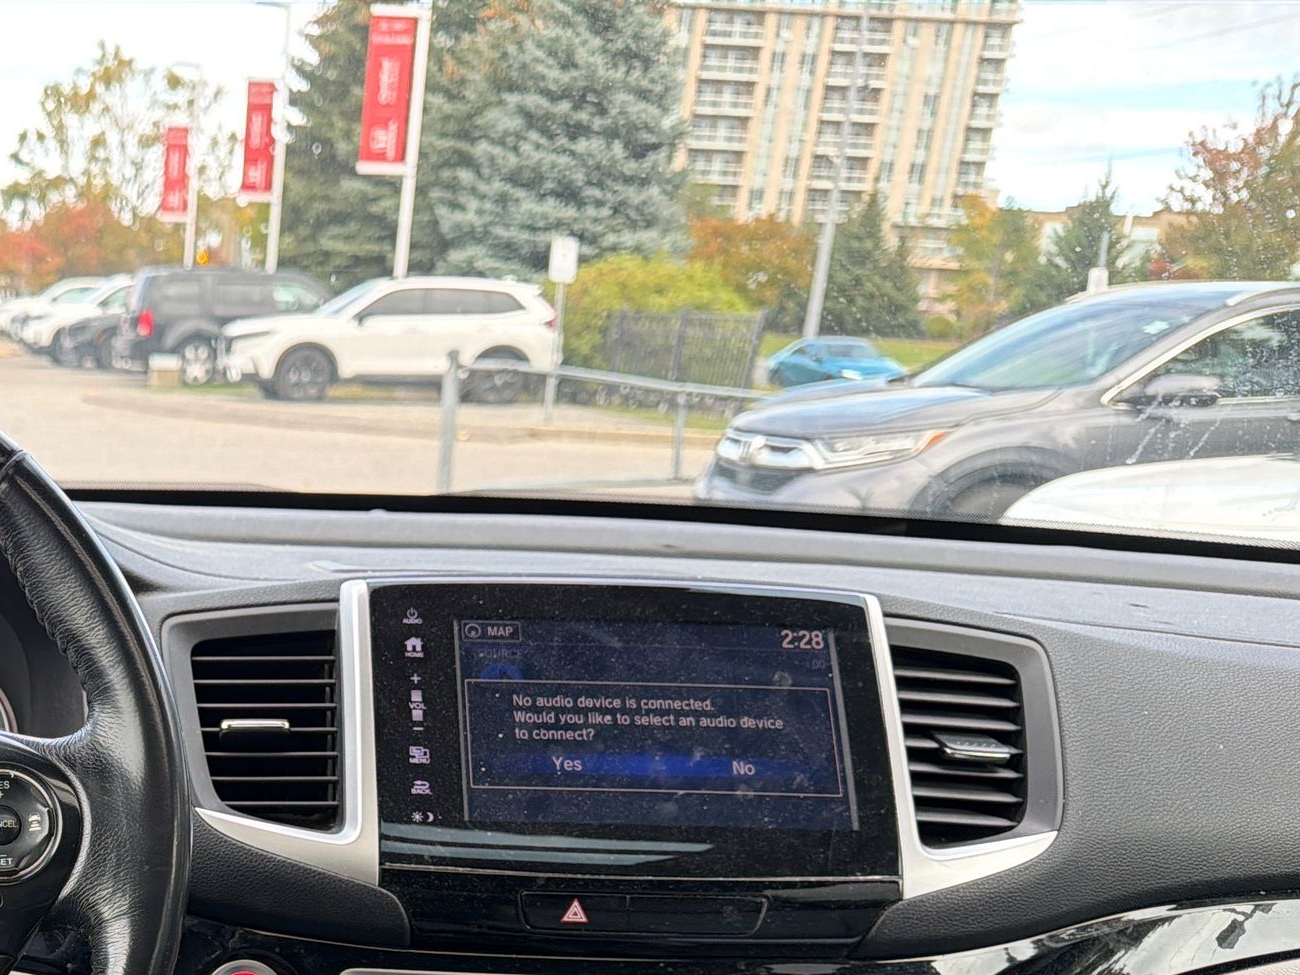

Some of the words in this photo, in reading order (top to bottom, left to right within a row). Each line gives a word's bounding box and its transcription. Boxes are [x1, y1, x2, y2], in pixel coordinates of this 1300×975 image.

[487, 626, 513, 637] MAP
[781, 629, 824, 649] 2:28
[409, 702, 426, 710] VOL
[512, 694, 532, 707] No
[536, 695, 573, 708] audio
[577, 695, 621, 708] device
[625, 696, 636, 709] is
[640, 698, 715, 711] connected.
[513, 710, 555, 724] Would
[558, 713, 583, 726] you
[588, 712, 613, 725] like
[617, 714, 630, 725] to
[634, 713, 675, 726] select
[679, 716, 695, 726] an
[699, 715, 736, 728] audio
[739, 715, 784, 729] device
[515, 728, 529, 739] to
[532, 728, 595, 741] connect?
[552, 756, 583, 771] Yes
[731, 760, 756, 775] No
